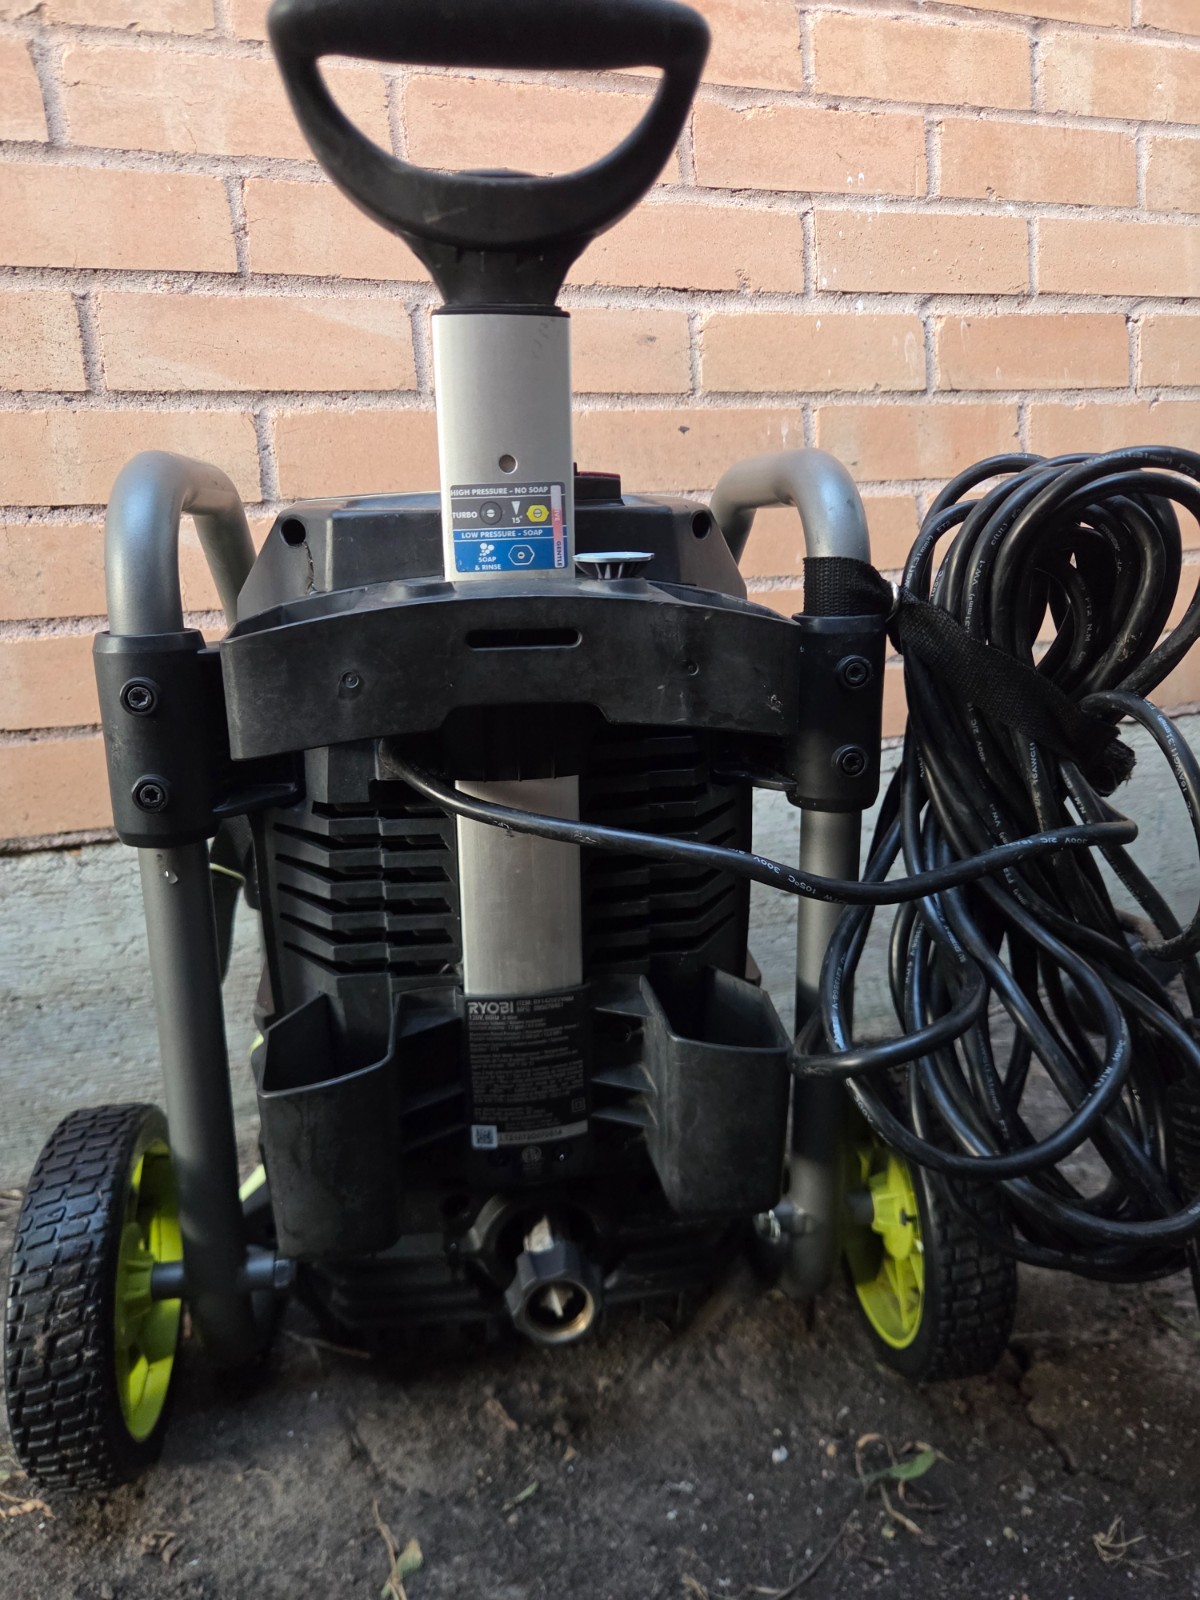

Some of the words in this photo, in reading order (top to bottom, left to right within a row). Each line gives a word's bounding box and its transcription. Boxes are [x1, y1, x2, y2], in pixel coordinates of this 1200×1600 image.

[450, 489, 470, 497] HIGH
[471, 487, 507, 496] PRESSURE
[528, 486, 549, 494] SOAP
[452, 511, 478, 519] TURBO
[480, 530, 516, 538] PRESSURE
[523, 529, 543, 537] SOAP
[972, 559, 986, 586] VW-1
[753, 856, 781, 874] 300V
[467, 1001, 514, 1014] RYOBI
